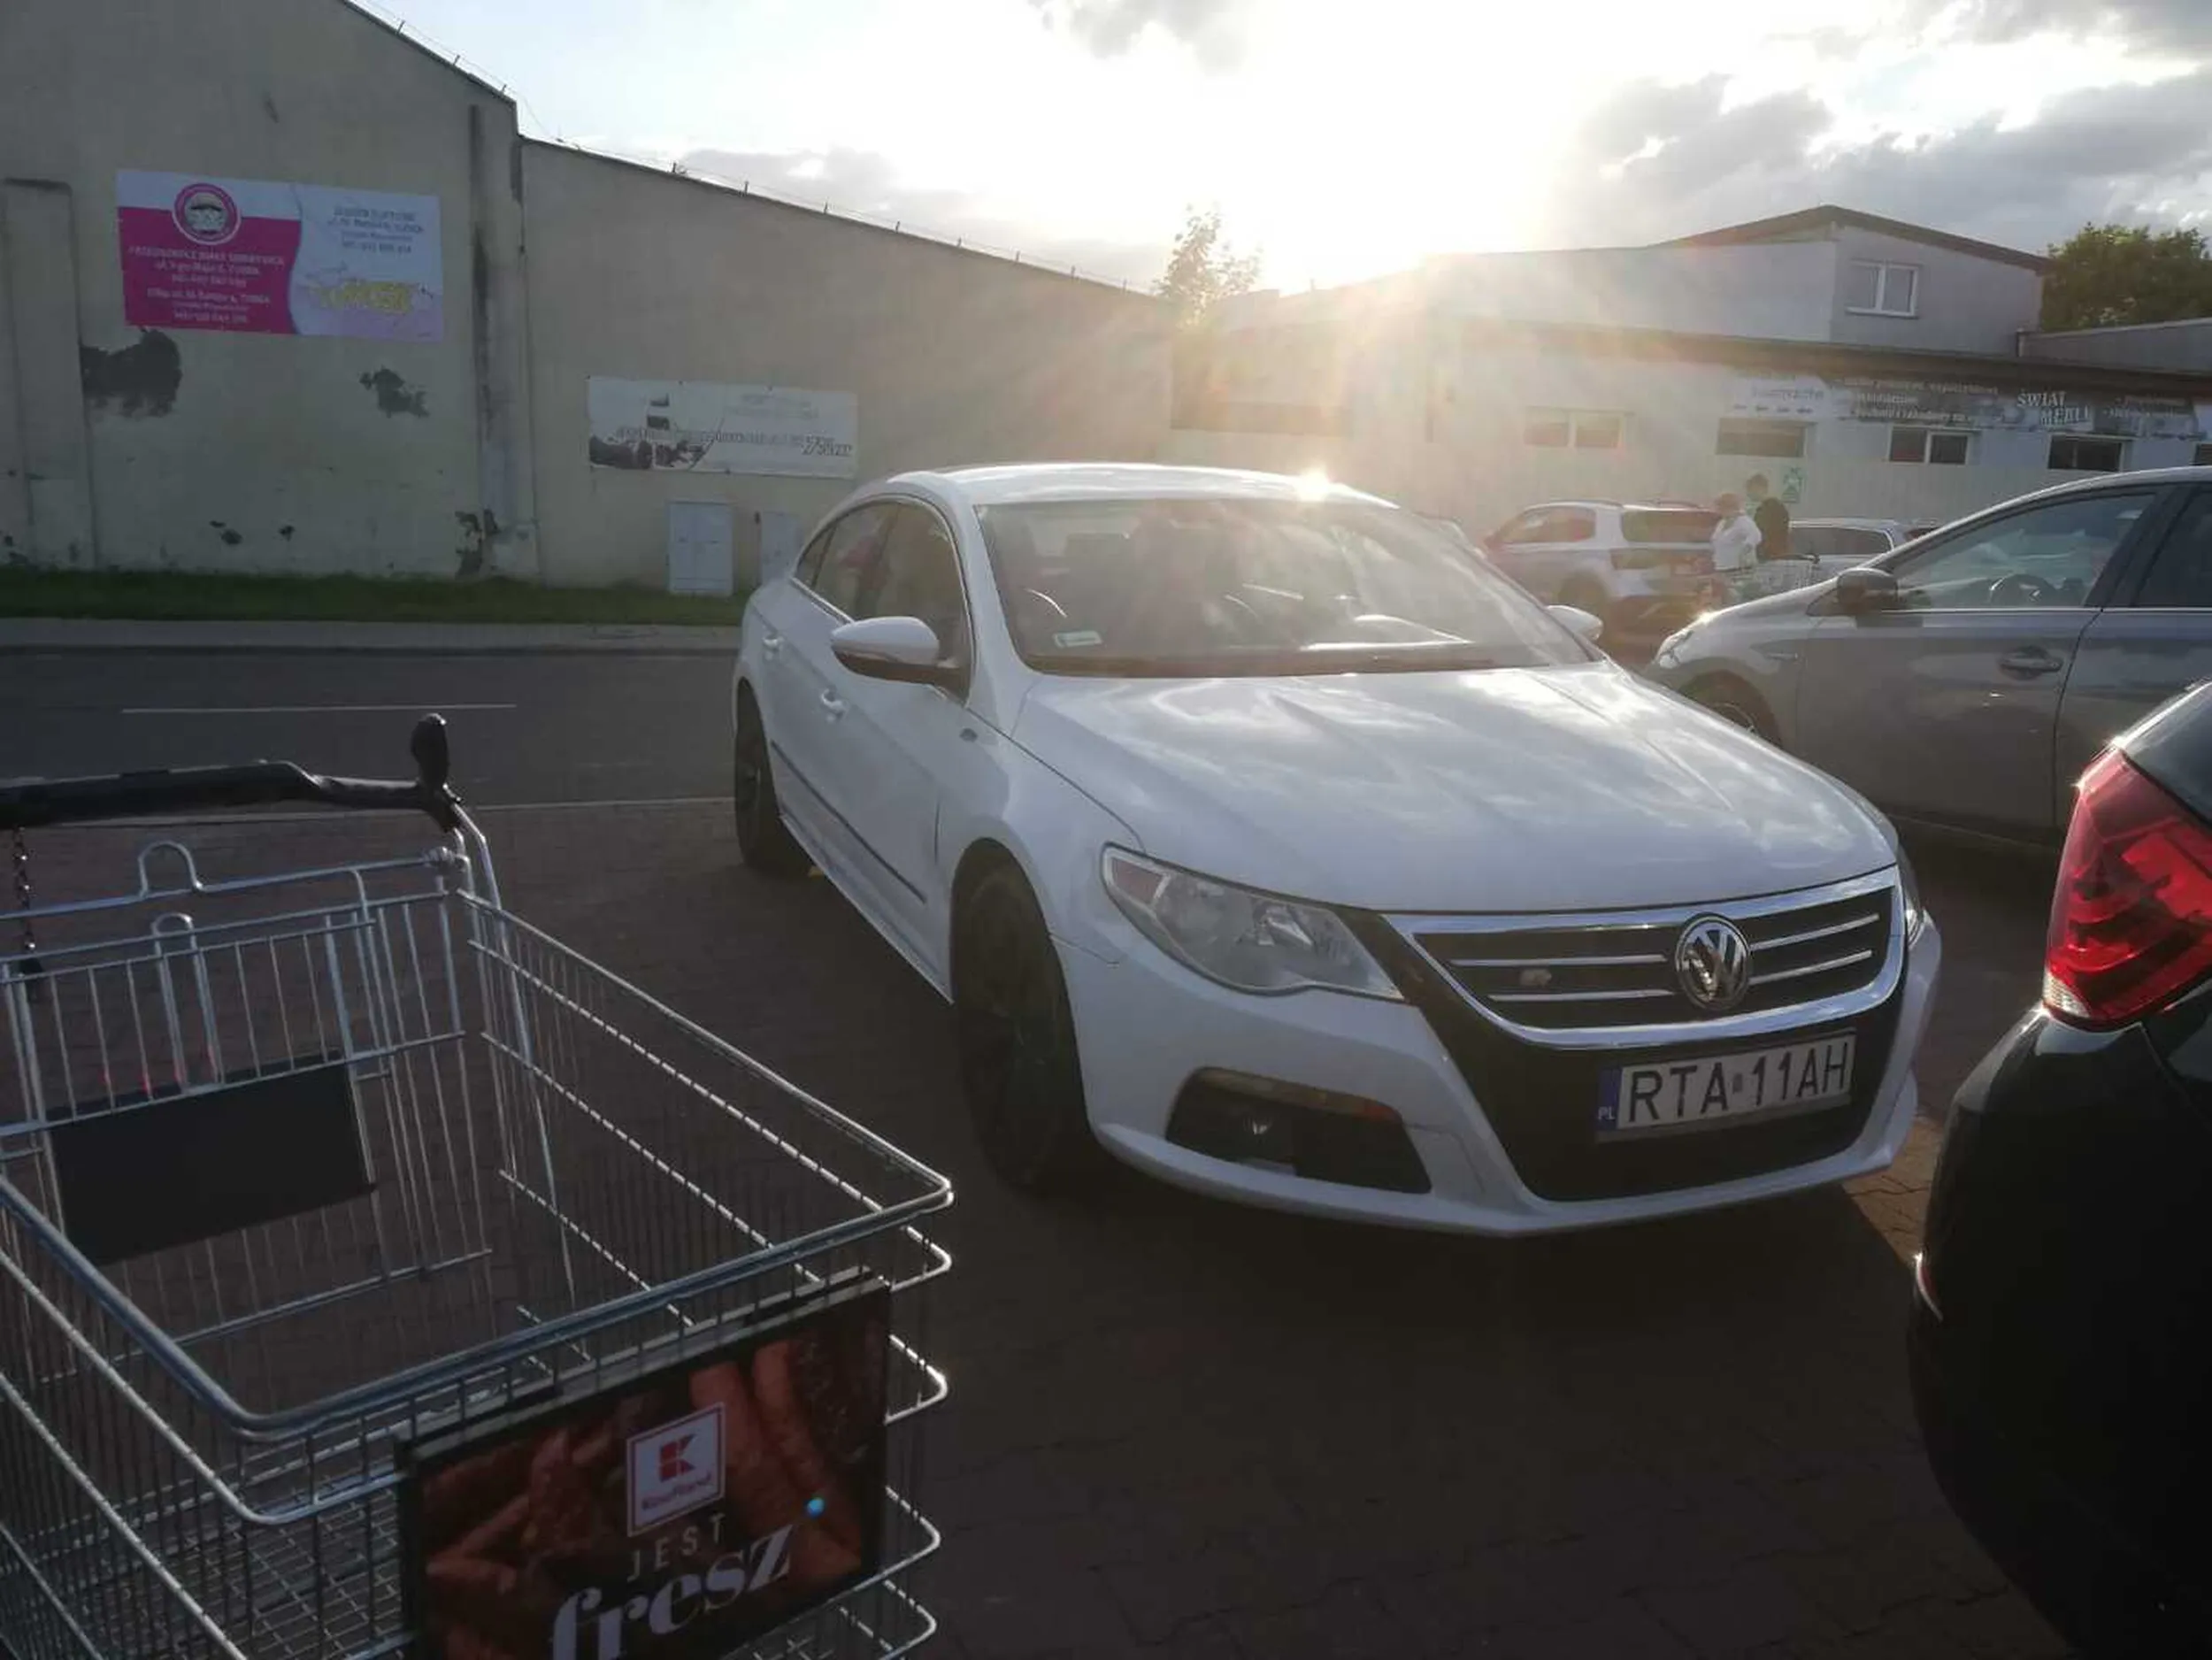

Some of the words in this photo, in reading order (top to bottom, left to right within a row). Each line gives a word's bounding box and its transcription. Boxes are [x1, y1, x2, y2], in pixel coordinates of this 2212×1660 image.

[1598, 1105, 1617, 1121] PL
[1629, 1061, 1729, 1123] RTA
[1751, 1041, 1847, 1106] 11AH
[627, 1512, 725, 1582] JEST
[552, 1524, 795, 1660] fresz
